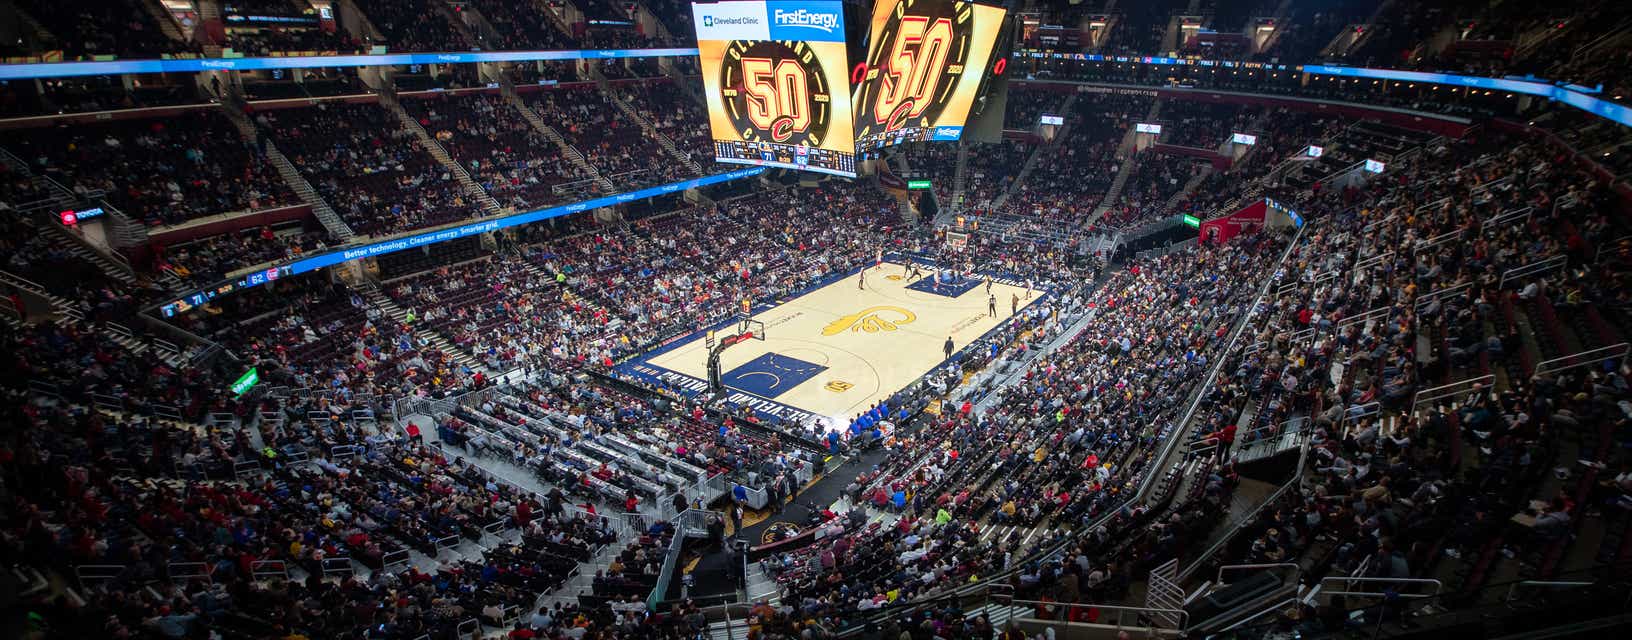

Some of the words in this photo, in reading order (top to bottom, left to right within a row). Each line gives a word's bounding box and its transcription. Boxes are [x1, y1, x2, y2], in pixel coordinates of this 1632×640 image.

[713, 17, 741, 25] Cleveland
[742, 17, 759, 25] Clinic
[874, 15, 954, 125] 50
[741, 57, 811, 134] 50
[764, 152, 773, 161] 71
[76, 208, 104, 219] TOYOTA
[344, 248, 368, 259] Better
[369, 240, 409, 255] technology.
[409, 235, 435, 245] Cleaner
[460, 224, 485, 235] Smarter
[192, 294, 203, 305] 71
